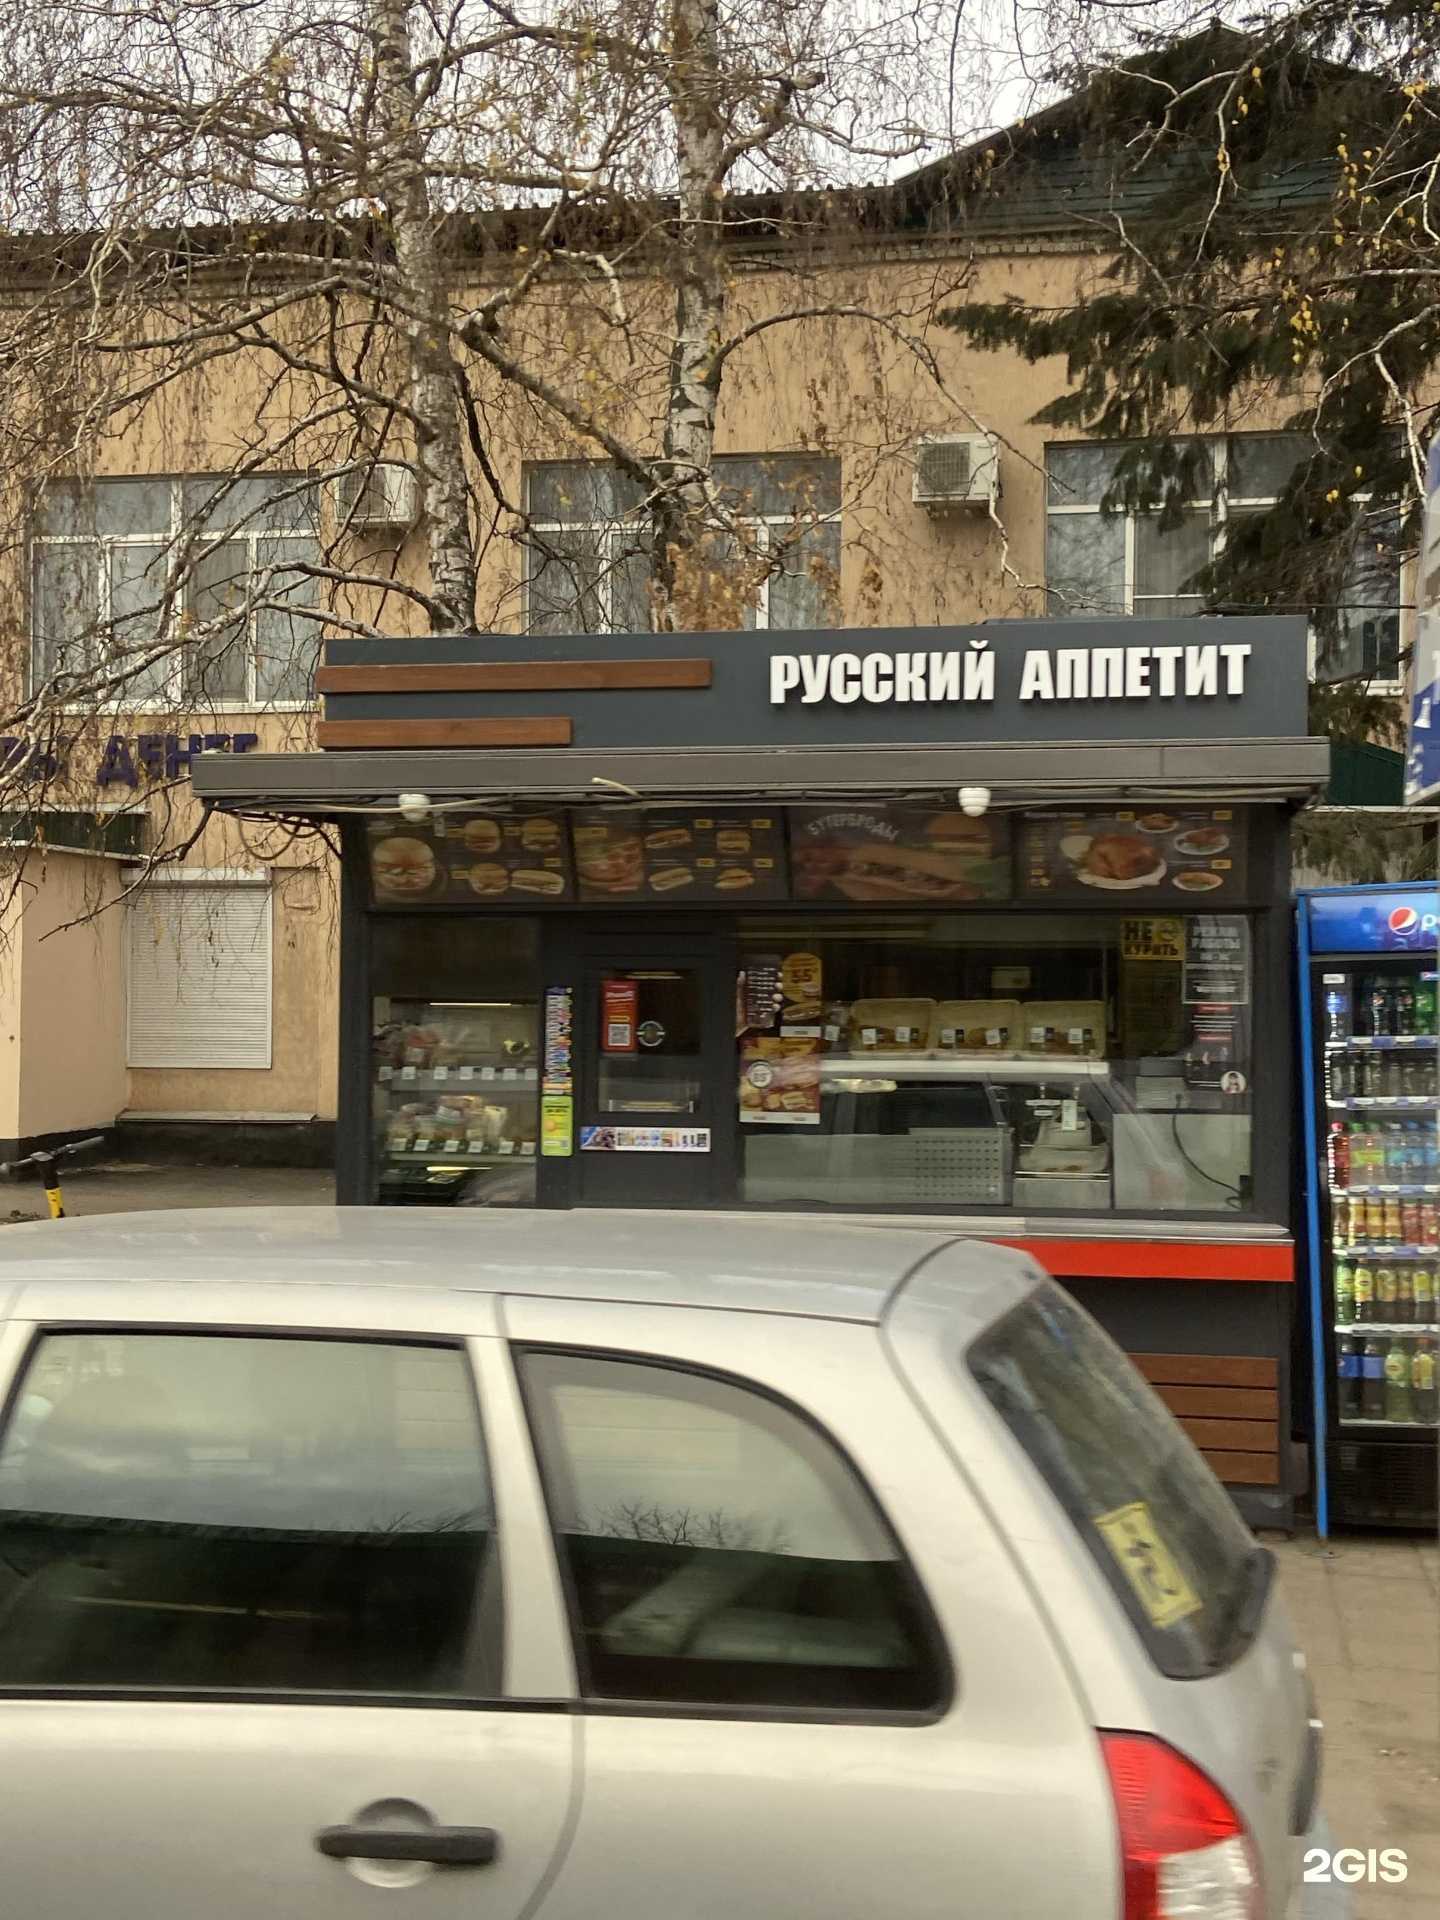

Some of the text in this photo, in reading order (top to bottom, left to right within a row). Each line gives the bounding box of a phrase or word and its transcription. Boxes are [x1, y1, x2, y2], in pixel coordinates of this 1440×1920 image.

[769, 639, 1252, 704] РУССКИЙ АППЕТИТ
[1124, 920, 1153, 941] НЕ
[1124, 943, 1178, 956] КУРИТЬ
